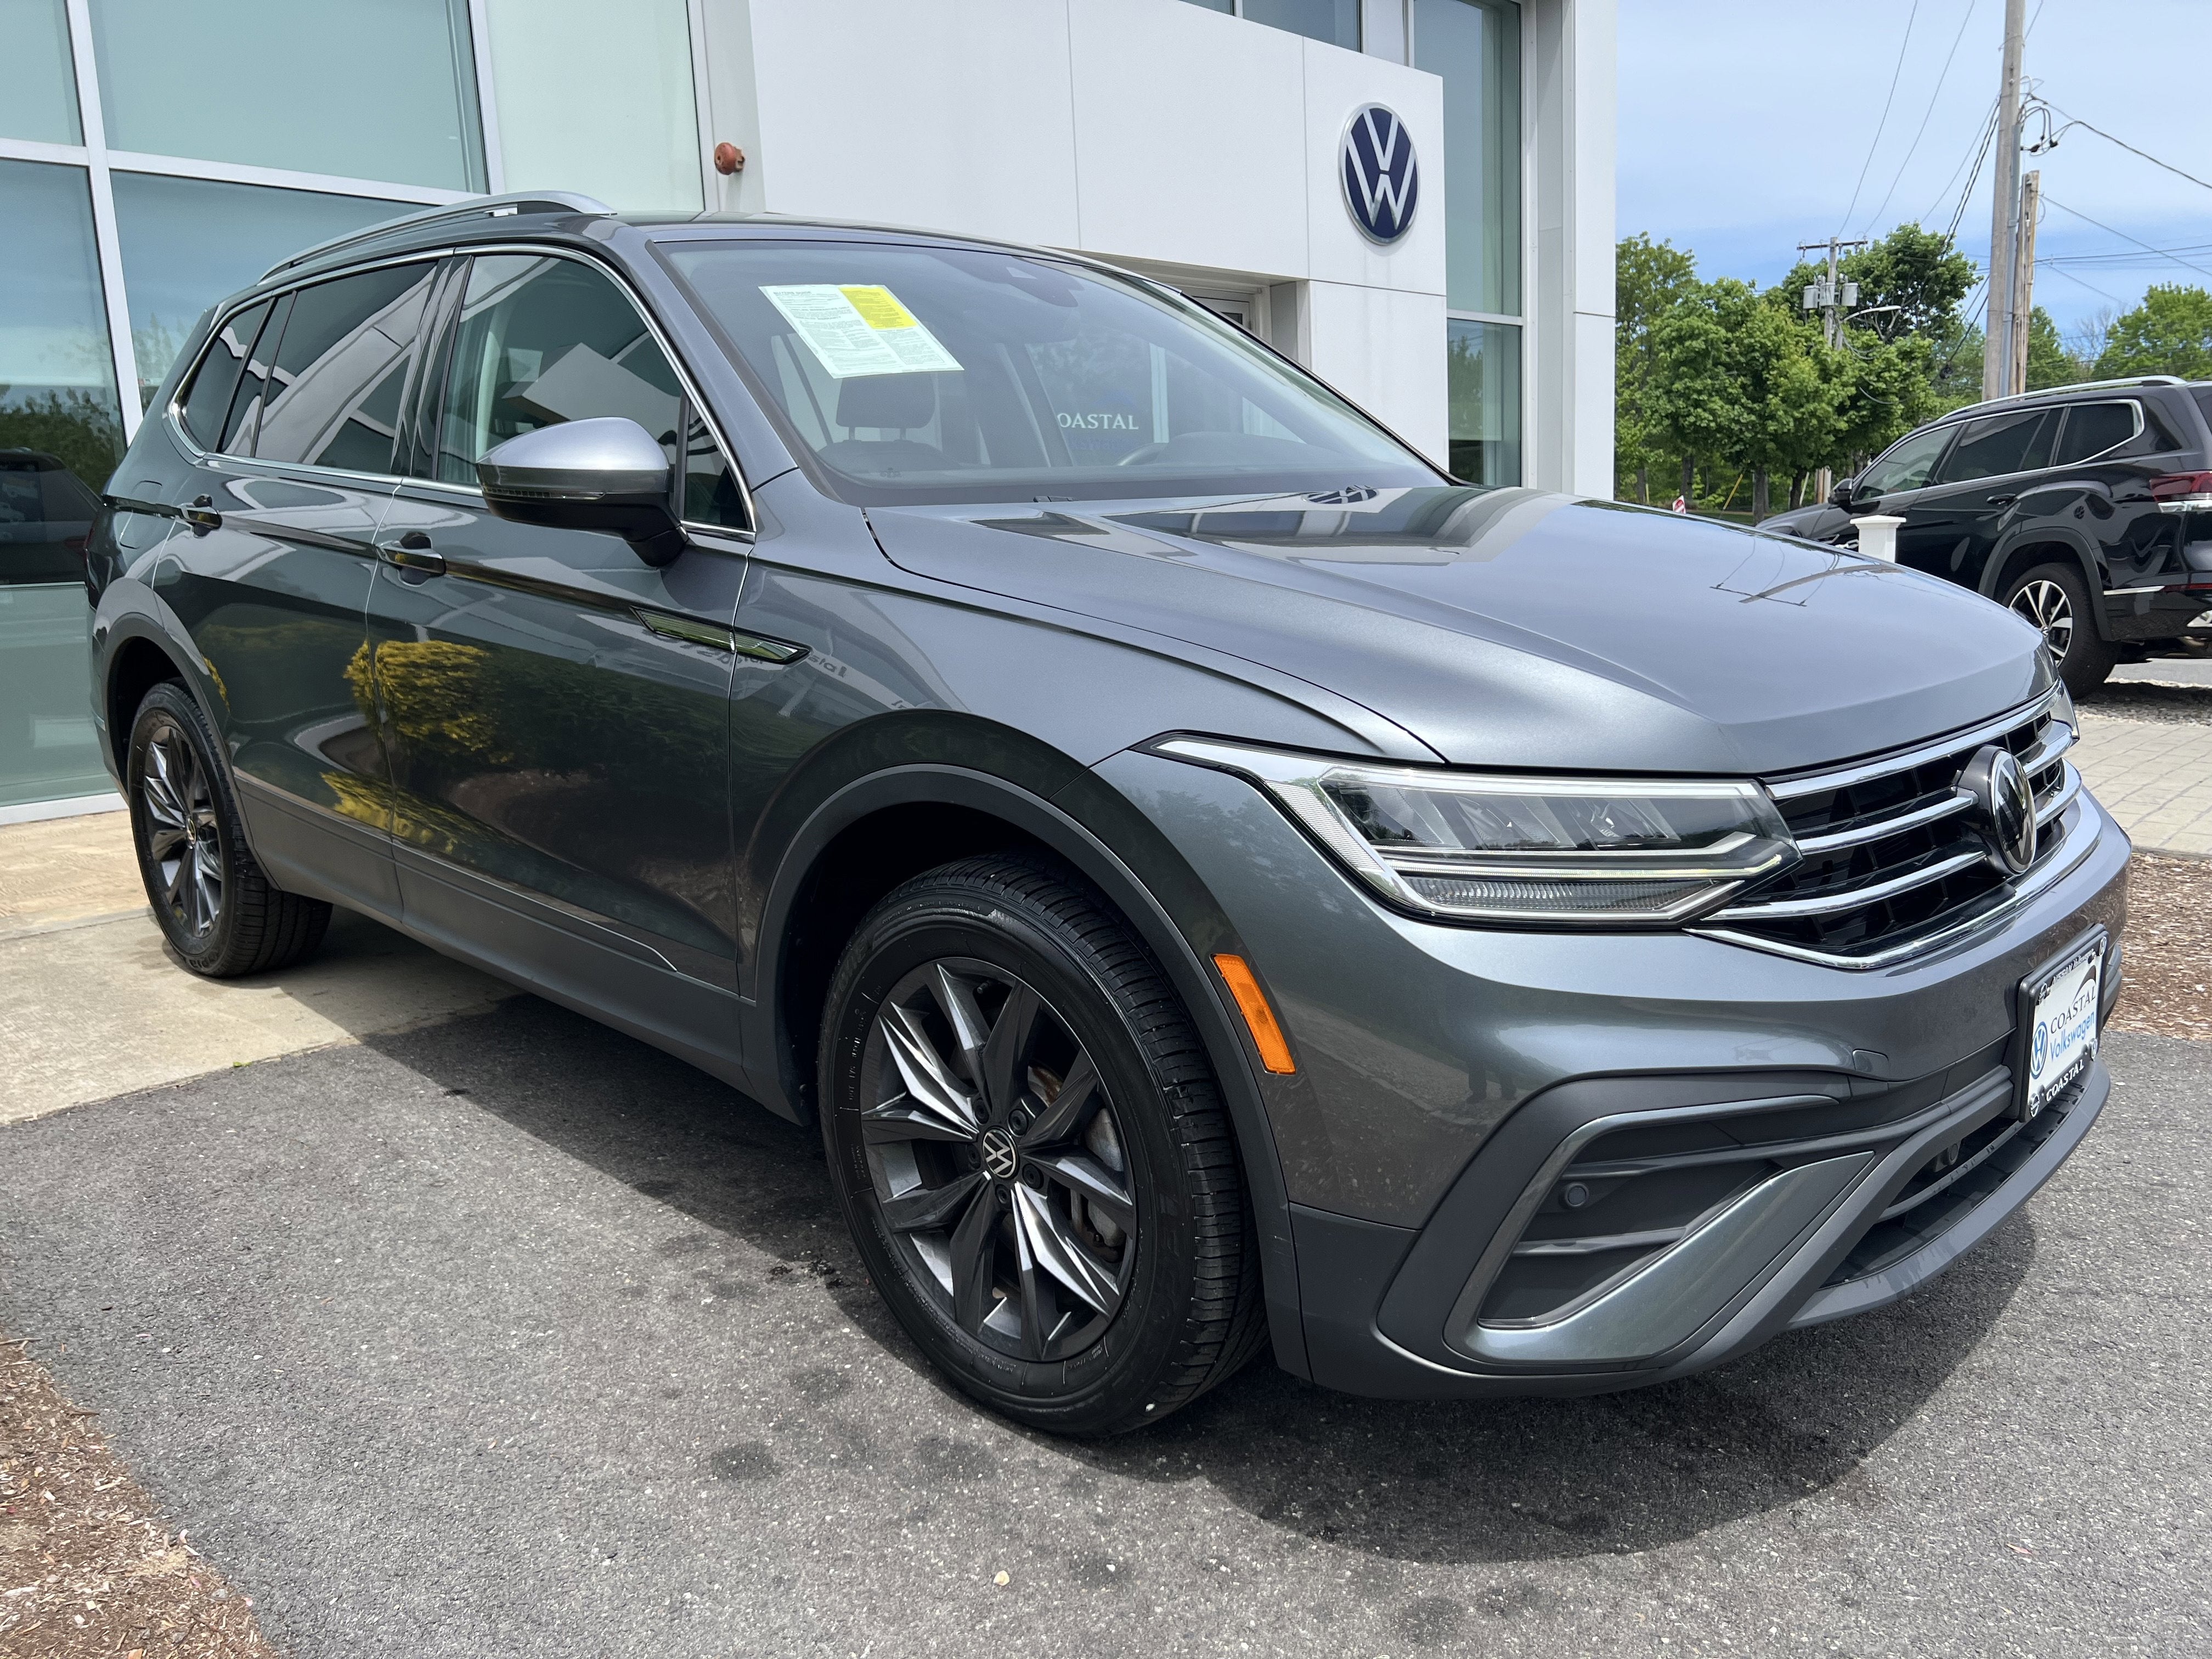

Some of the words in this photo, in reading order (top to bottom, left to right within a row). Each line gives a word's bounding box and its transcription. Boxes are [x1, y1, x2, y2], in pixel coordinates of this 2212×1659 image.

[1057, 413, 1139, 430] OASTAL
[2050, 986, 2096, 1034] COASTAL
[2050, 1011, 2095, 1062] Volkswagen
[2046, 1059, 2085, 1102] COASTAL
